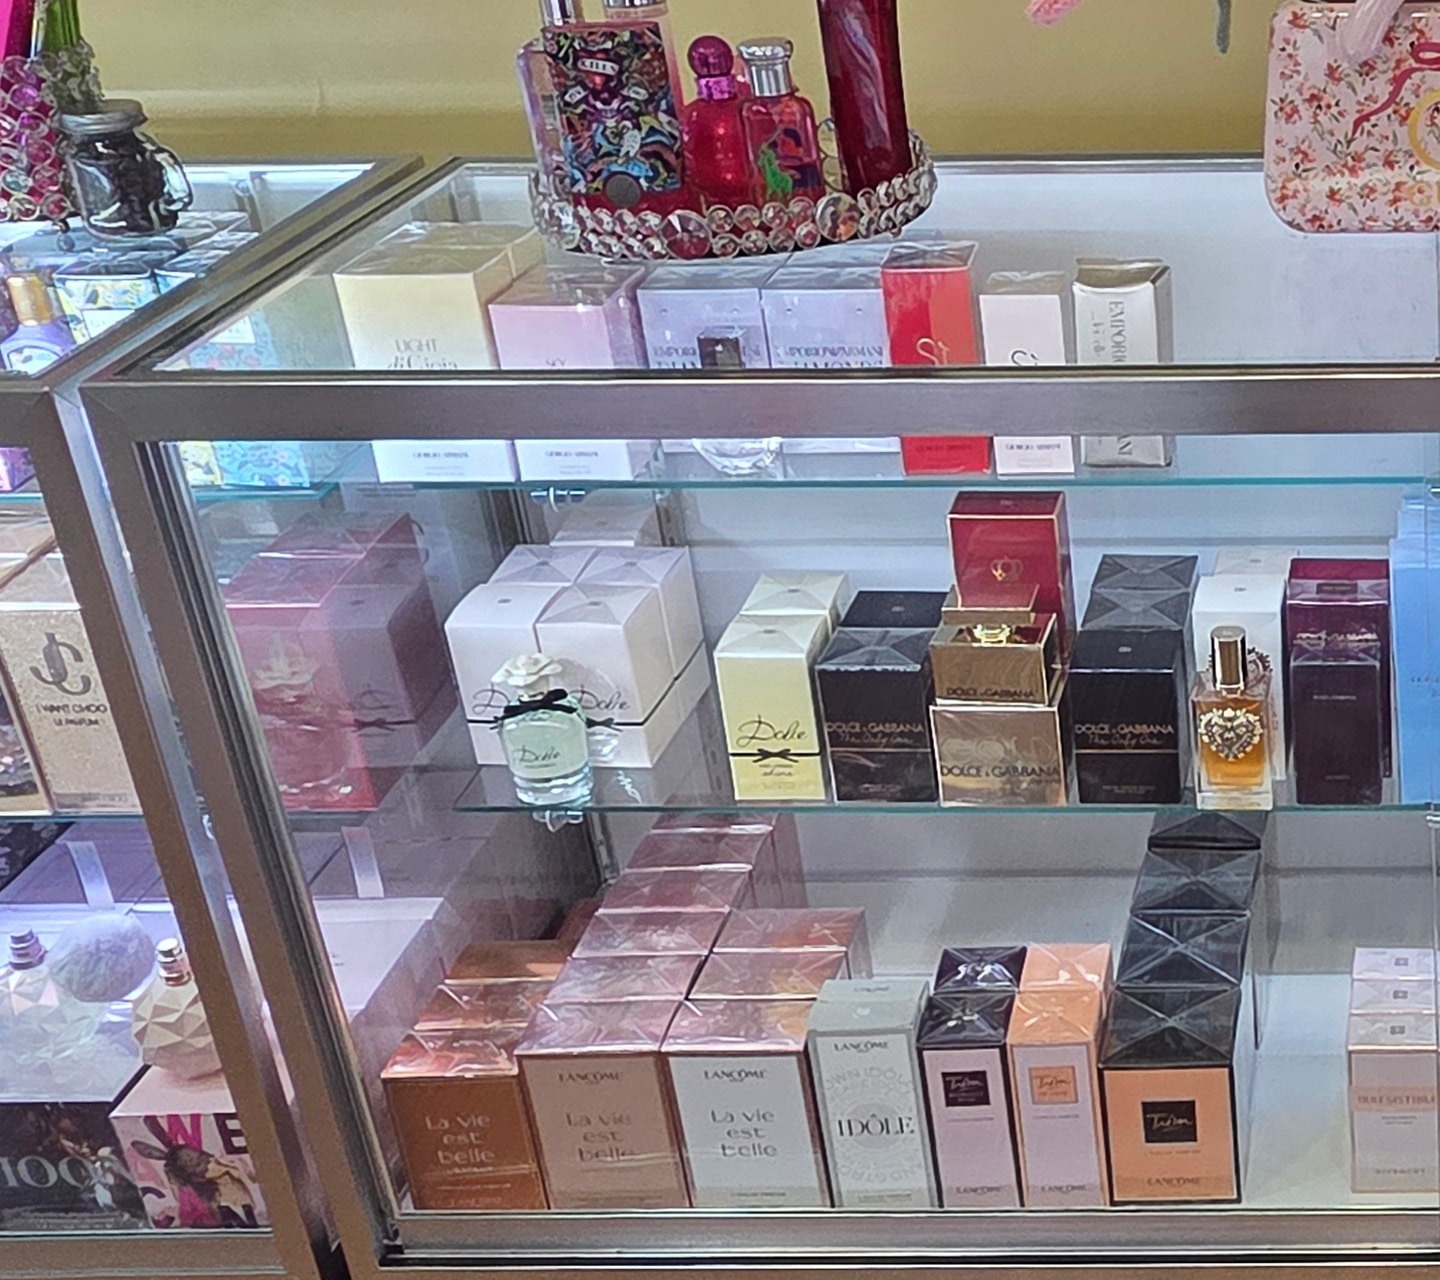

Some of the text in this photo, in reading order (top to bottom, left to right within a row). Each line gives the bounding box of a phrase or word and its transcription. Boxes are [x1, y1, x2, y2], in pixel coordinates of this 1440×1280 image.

[736, 714, 808, 748] Dolce
[425, 1113, 491, 1130] La vie
[711, 1107, 775, 1124] La vie
[725, 1126, 767, 1140] est
[837, 1112, 915, 1137] IDÔLE
[442, 1131, 483, 1145] est
[582, 1130, 624, 1144] est
[437, 1148, 496, 1166] belle
[720, 1142, 778, 1158] belle
